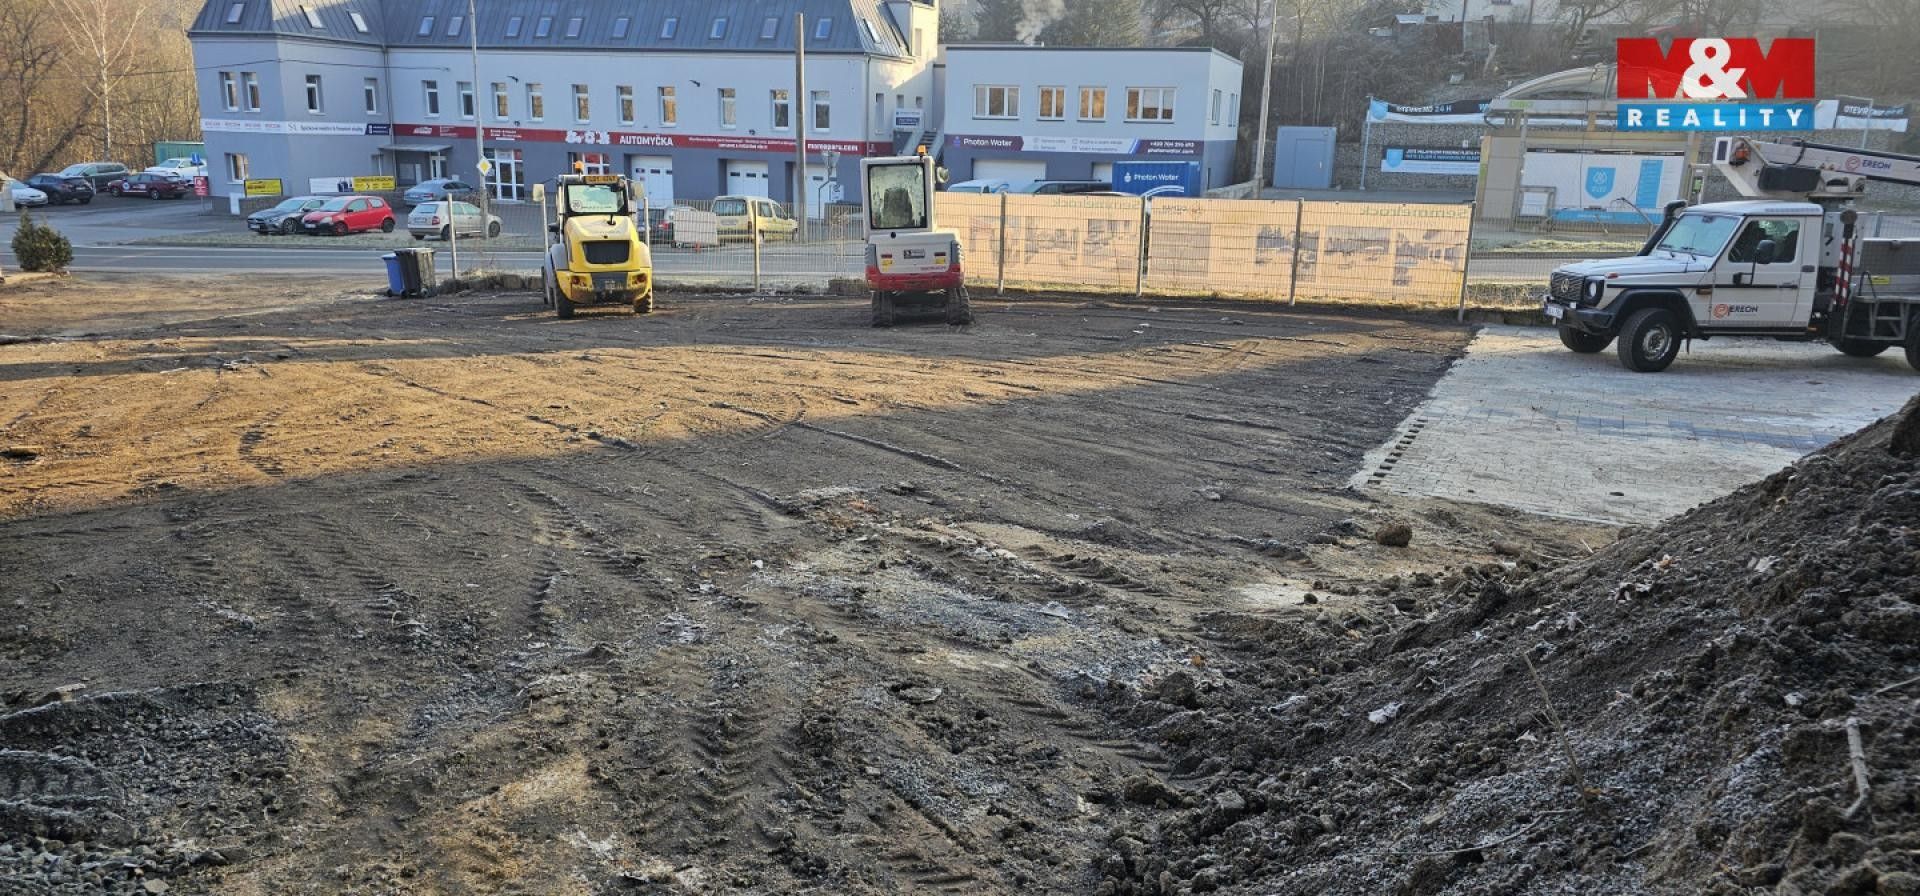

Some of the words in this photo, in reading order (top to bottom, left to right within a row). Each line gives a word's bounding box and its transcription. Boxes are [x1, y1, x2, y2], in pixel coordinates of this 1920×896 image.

[620, 135, 673, 146] AUTOMYČKA
[963, 138, 989, 146] Photon
[990, 139, 1013, 147] Water
[1862, 159, 1892, 169] EREON
[1729, 304, 1759, 313] EREON
